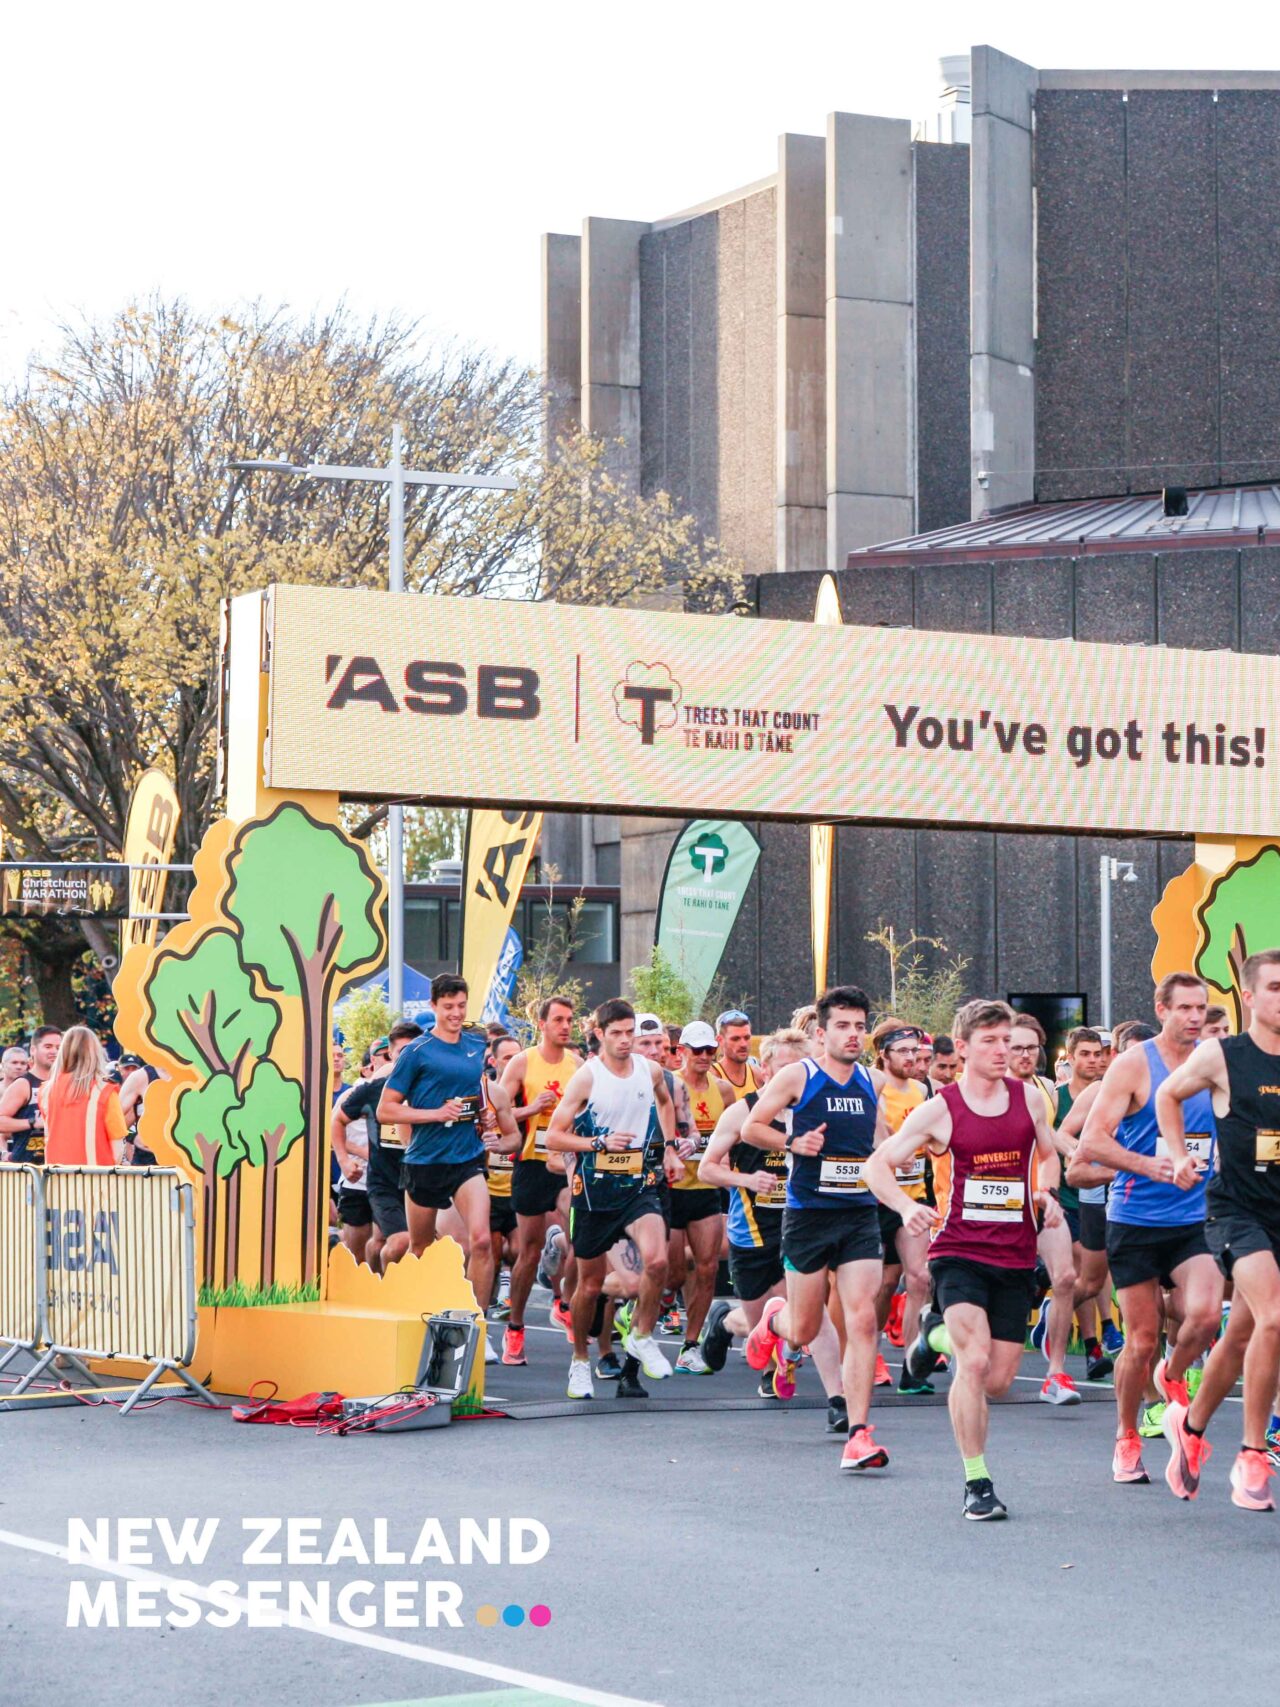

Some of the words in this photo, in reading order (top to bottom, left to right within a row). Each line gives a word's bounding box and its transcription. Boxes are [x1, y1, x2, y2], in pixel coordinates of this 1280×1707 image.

[326, 655, 541, 720] ASB
[683, 706, 728, 726] TREES
[733, 709, 768, 728] THAT
[773, 711, 820, 731] COUNT
[683, 729, 700, 748] TE
[705, 730, 739, 750] RAHI
[744, 732, 753, 751] O
[884, 704, 1048, 755] You've
[1066, 720, 1143, 768] got
[1162, 721, 1266, 768] this!
[22, 869, 52, 877] ASB
[22, 879, 87, 889] Christchurch
[22, 889, 87, 899] MARATHON
[826, 1097, 865, 1112] LEITH
[608, 1155, 631, 1164] 2497
[973, 1151, 1021, 1165] UNIVERSITY
[835, 1165, 860, 1175] 5538
[982, 1184, 1009, 1196] 5759
